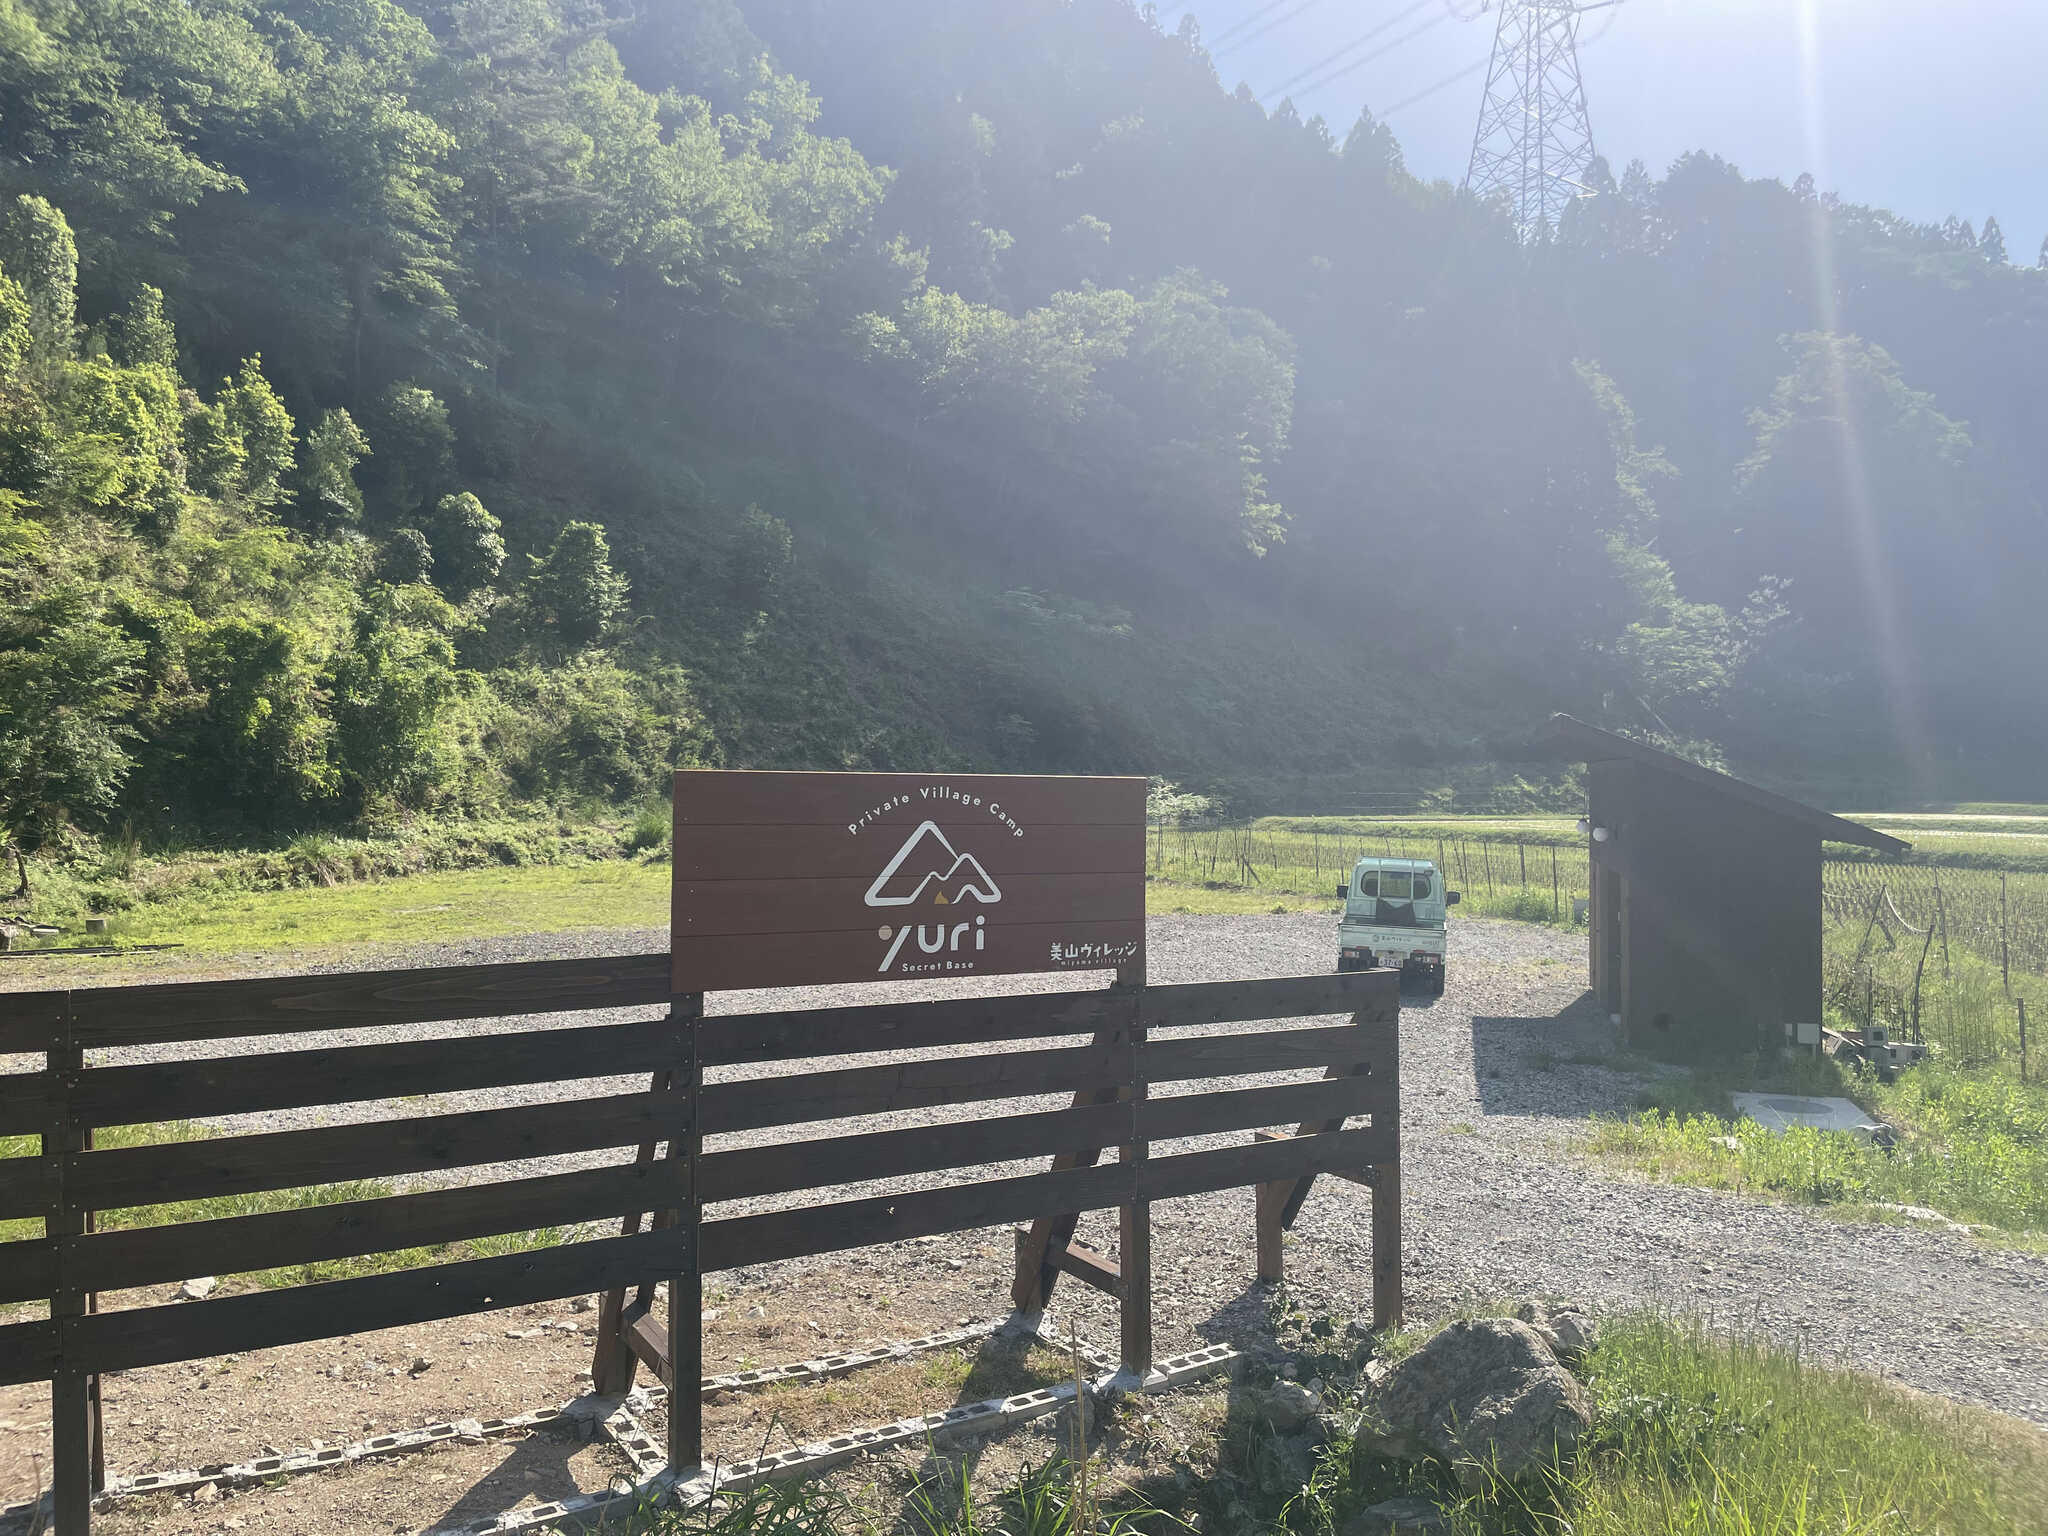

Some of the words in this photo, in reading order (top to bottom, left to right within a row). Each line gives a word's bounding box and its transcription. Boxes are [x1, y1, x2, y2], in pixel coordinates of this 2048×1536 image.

[848, 793, 911, 836] Private
[919, 786, 982, 806] Village
[989, 802, 1024, 838] Camp
[1050, 941, 1138, 961] 美山ヴィレッジ
[901, 961, 942, 972] Secret
[946, 960, 974, 970] Base
